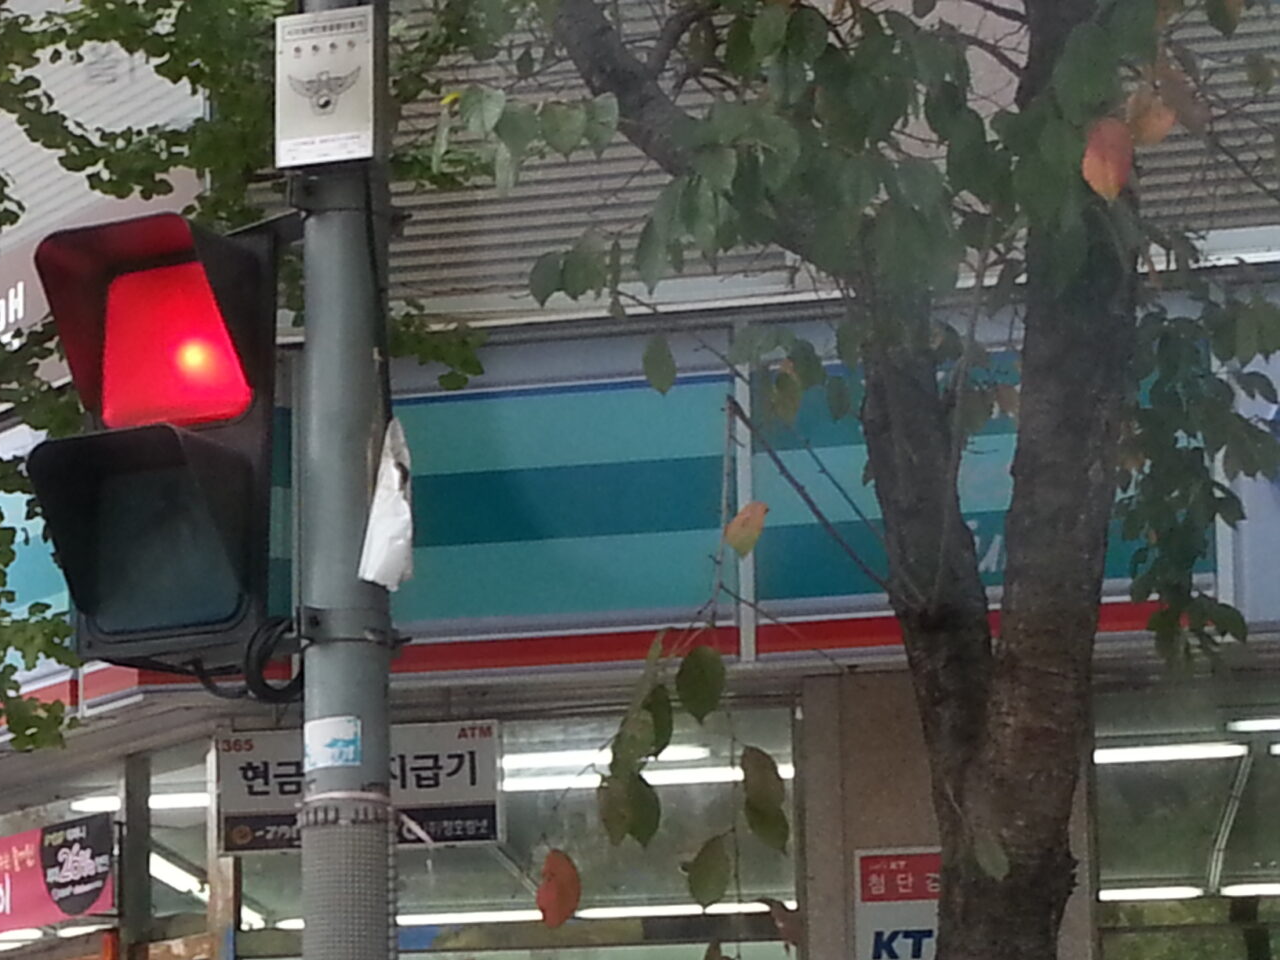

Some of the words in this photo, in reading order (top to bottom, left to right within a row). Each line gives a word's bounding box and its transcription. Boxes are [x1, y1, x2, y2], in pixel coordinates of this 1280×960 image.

[221, 739, 254, 752] 365
[457, 726, 492, 740] ATM
[872, 929, 933, 960] KT
